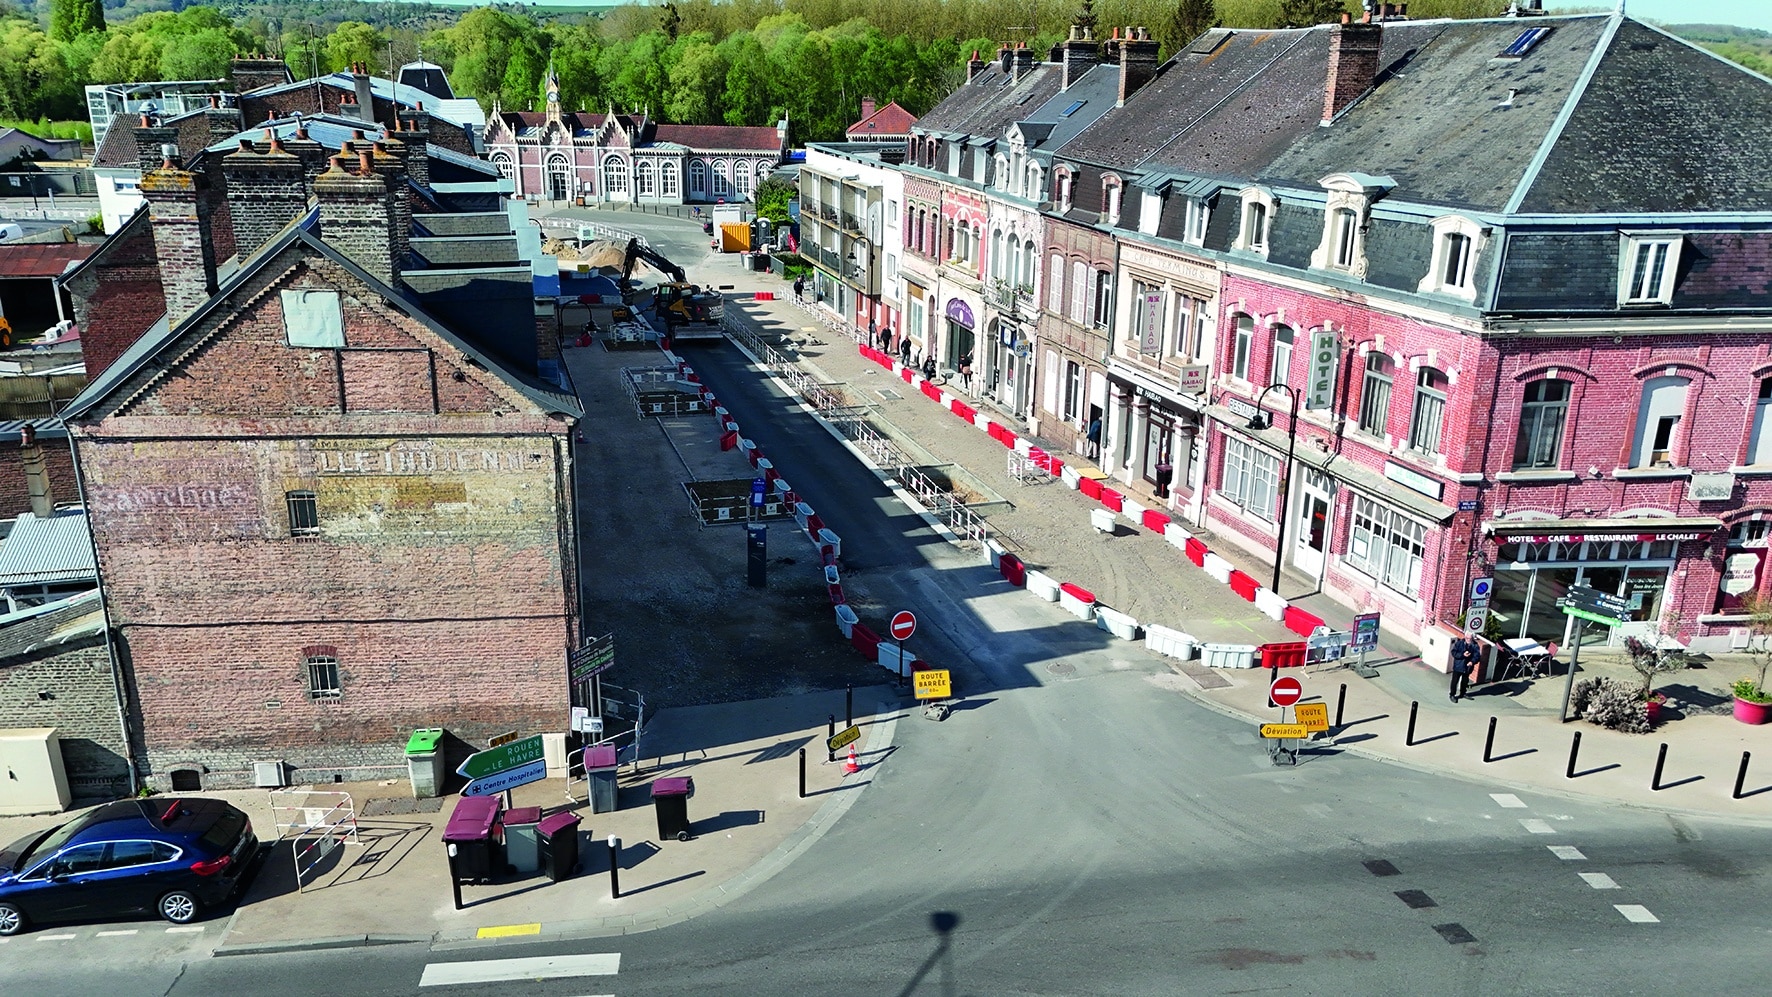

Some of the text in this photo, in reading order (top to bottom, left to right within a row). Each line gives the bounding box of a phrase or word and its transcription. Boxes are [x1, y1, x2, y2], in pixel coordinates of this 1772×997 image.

[1015, 344, 1029, 353] gan
[1315, 336, 1334, 405] HOTEL
[1182, 378, 1204, 386] HAIBAO
[1229, 397, 1269, 423] RESTAURNT
[1507, 535, 1536, 543] HOTEL
[1583, 534, 1638, 542] RESTAURANT
[1667, 533, 1700, 541] CHALET
[1471, 619, 1480, 627] 30
[920, 672, 943, 680] ROUTE
[918, 679, 947, 688] BARRÉE
[1266, 727, 1302, 735] Déviation
[507, 739, 540, 756] ROUEN
[492, 748, 541, 770] LE HAVRE
[483, 767, 544, 791] Centre Hospitalier
